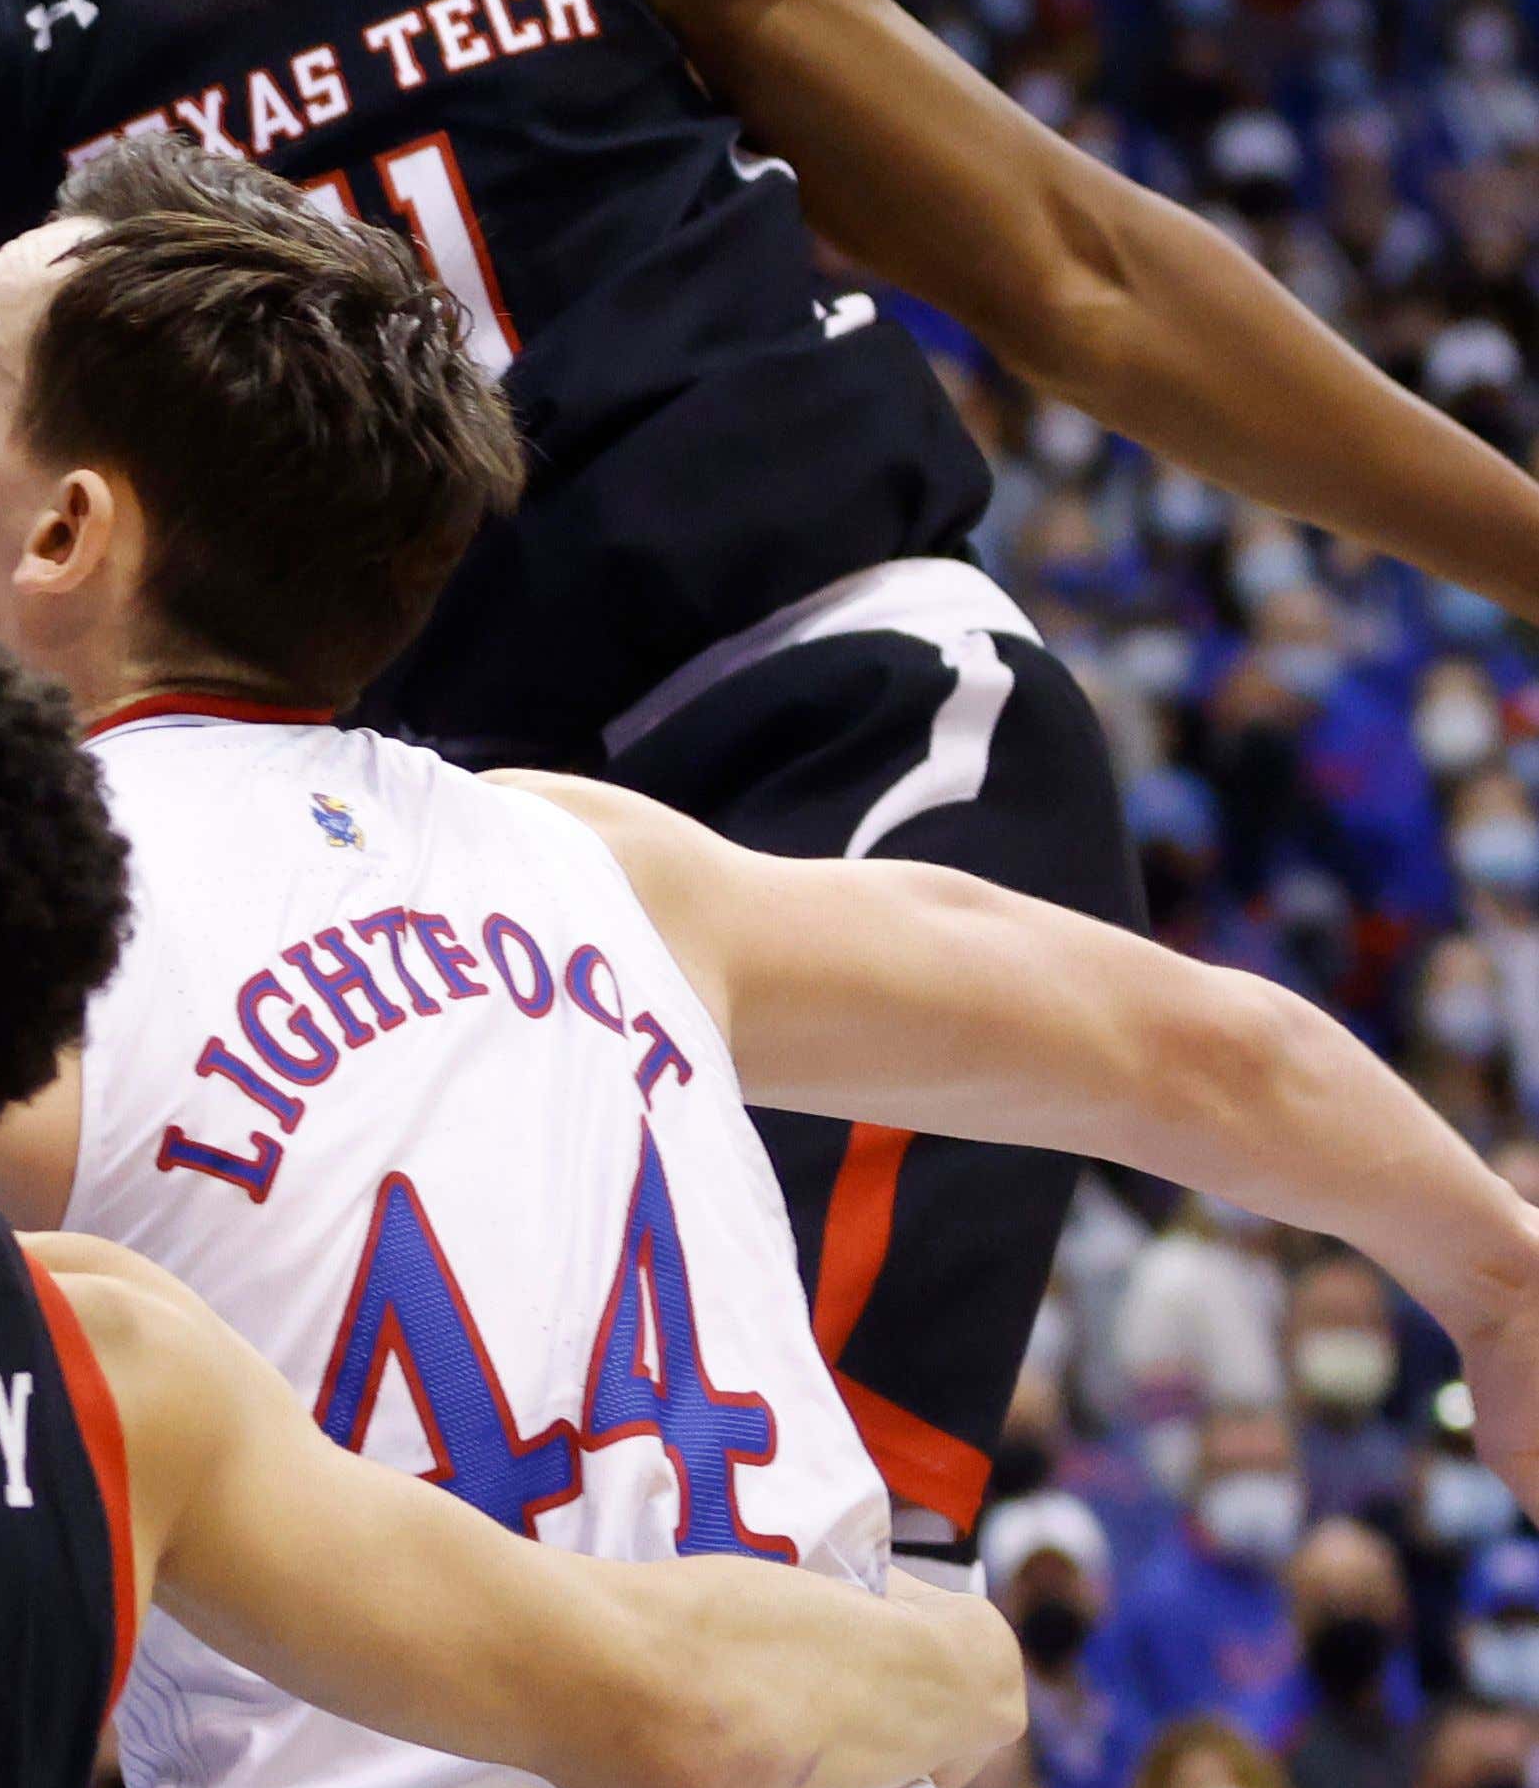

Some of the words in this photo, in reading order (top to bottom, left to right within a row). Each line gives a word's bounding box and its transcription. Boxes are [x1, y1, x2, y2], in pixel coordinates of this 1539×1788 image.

[64, 44, 353, 171] XAS
[290, 130, 522, 383] 1
[156, 905, 693, 1205] LIGHTFOOT
[314, 1115, 798, 1565] 44
